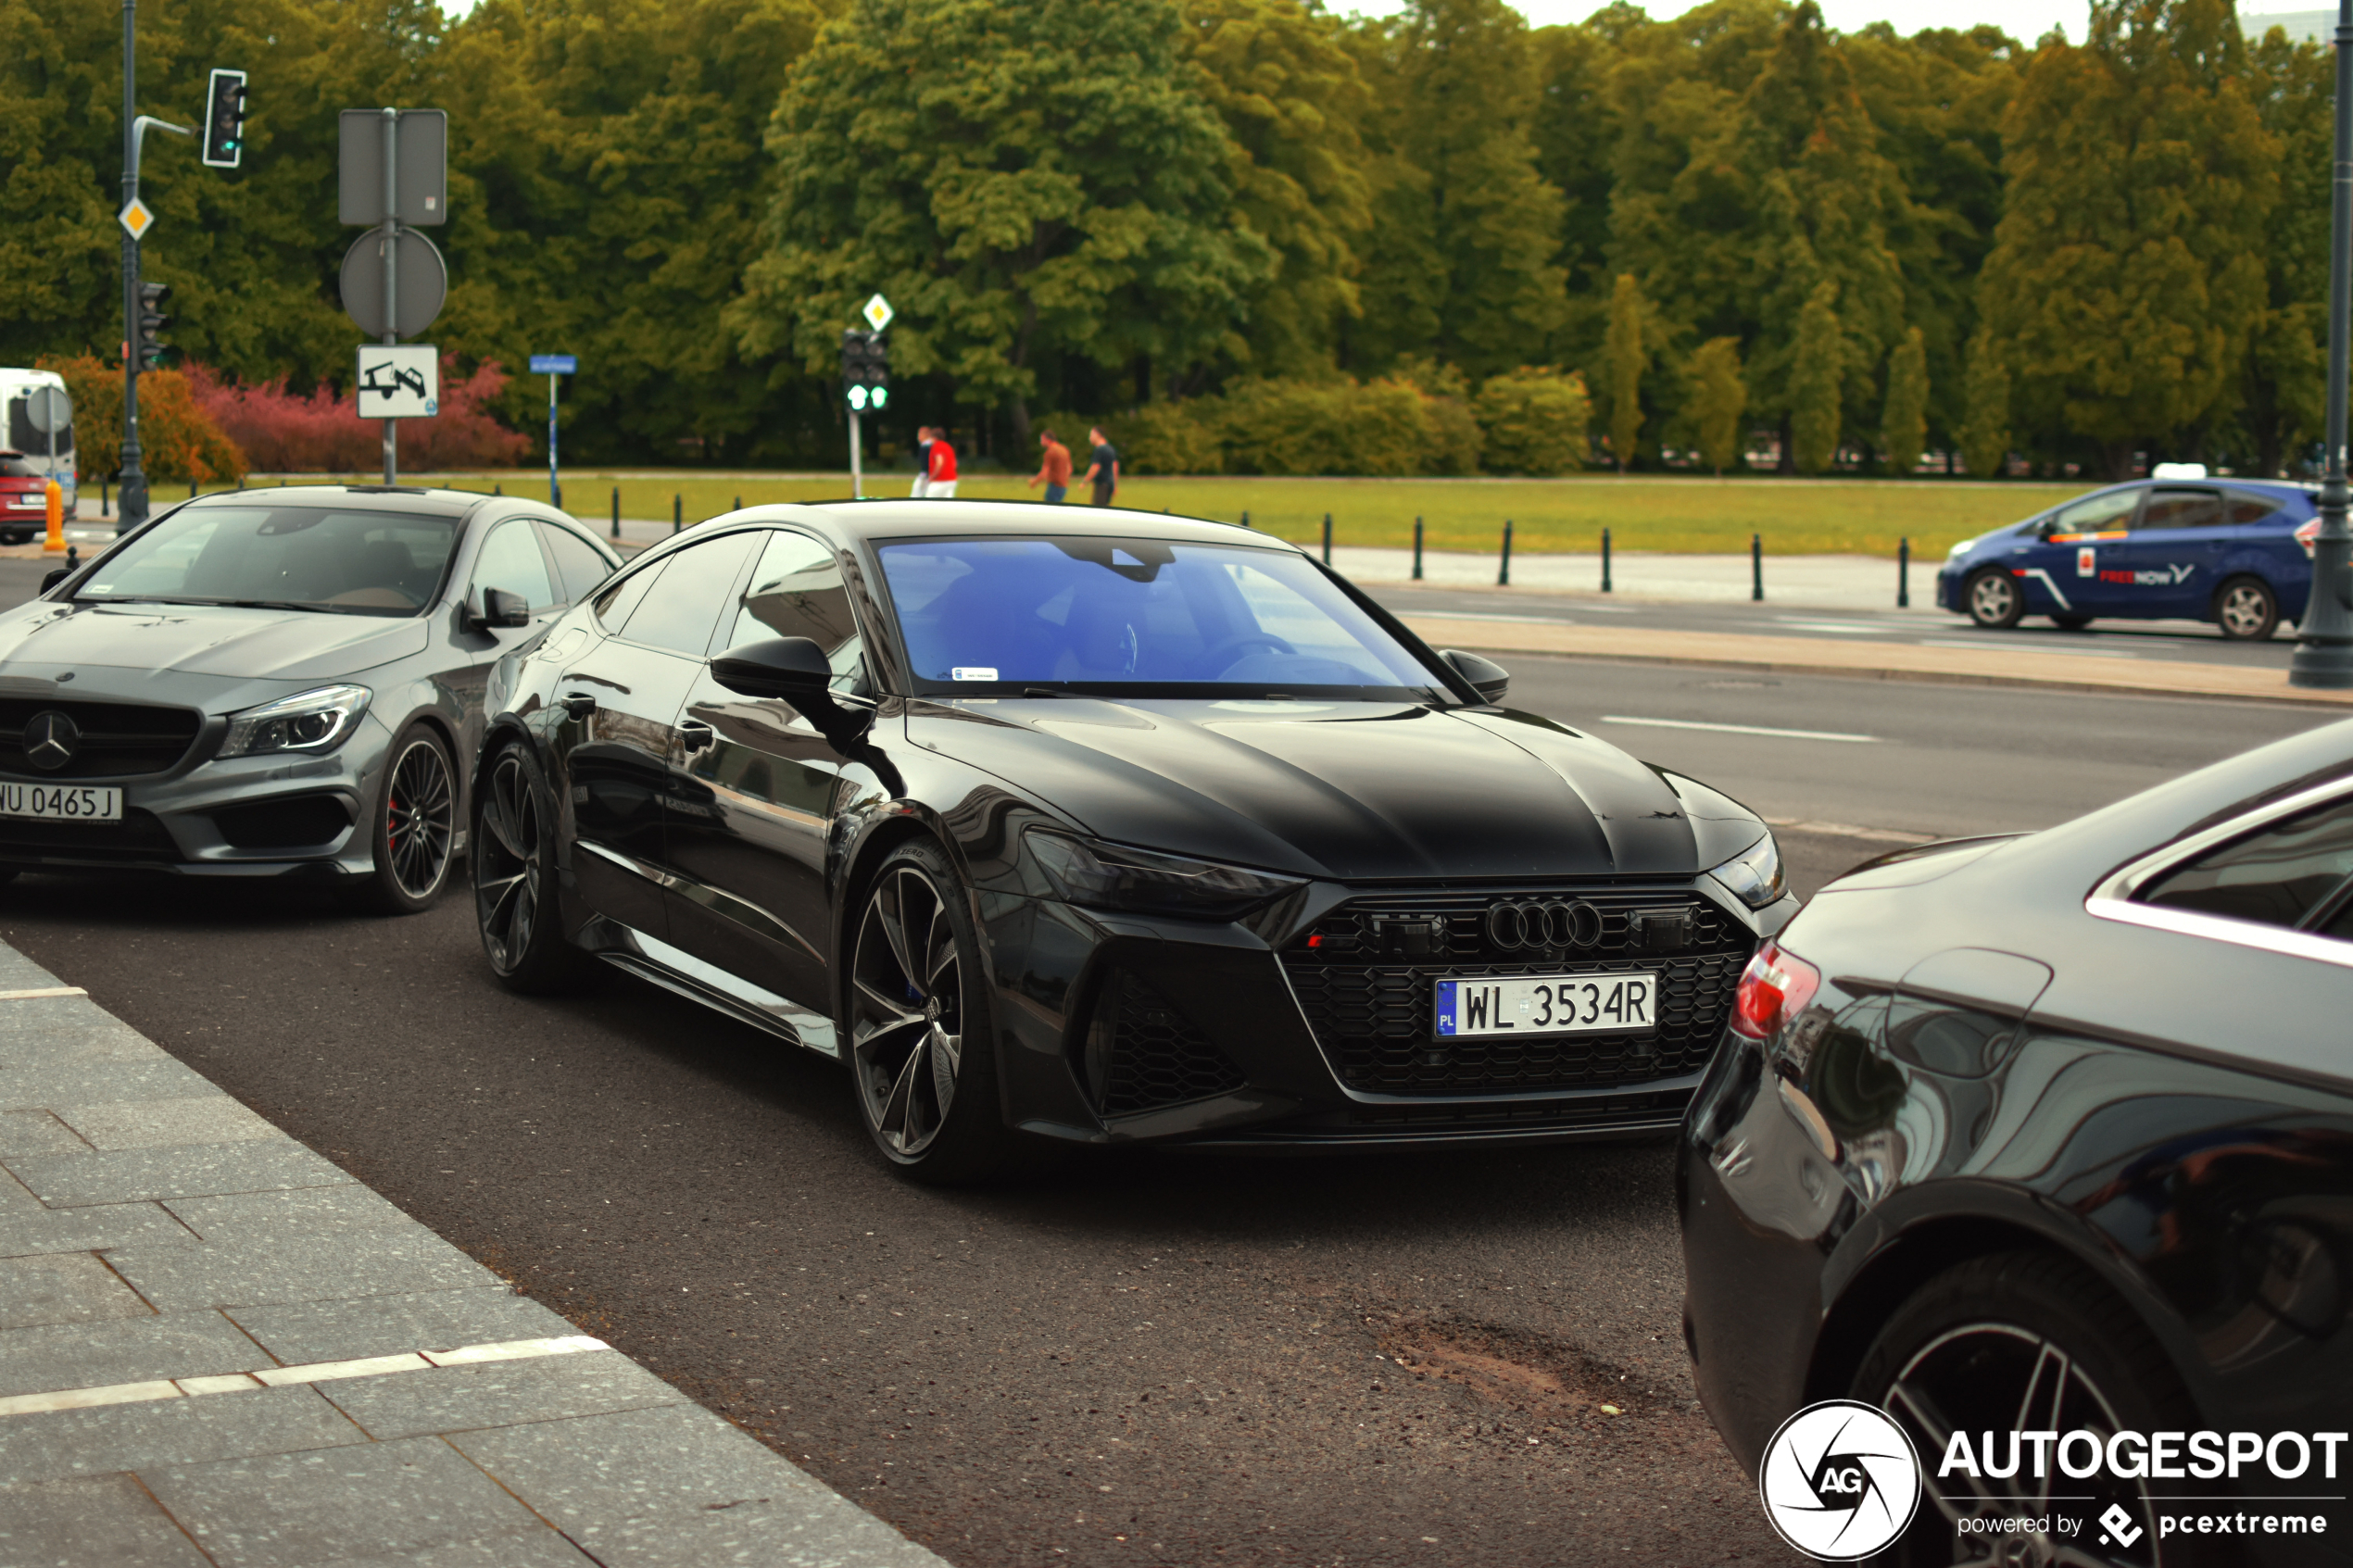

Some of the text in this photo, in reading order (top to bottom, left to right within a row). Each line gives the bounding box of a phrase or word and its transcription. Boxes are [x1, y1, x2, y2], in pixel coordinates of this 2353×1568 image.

[900, 847, 925, 858] ZERO
[1466, 980, 1647, 1029] WL 3534R
[1440, 1015, 1454, 1026] PL
